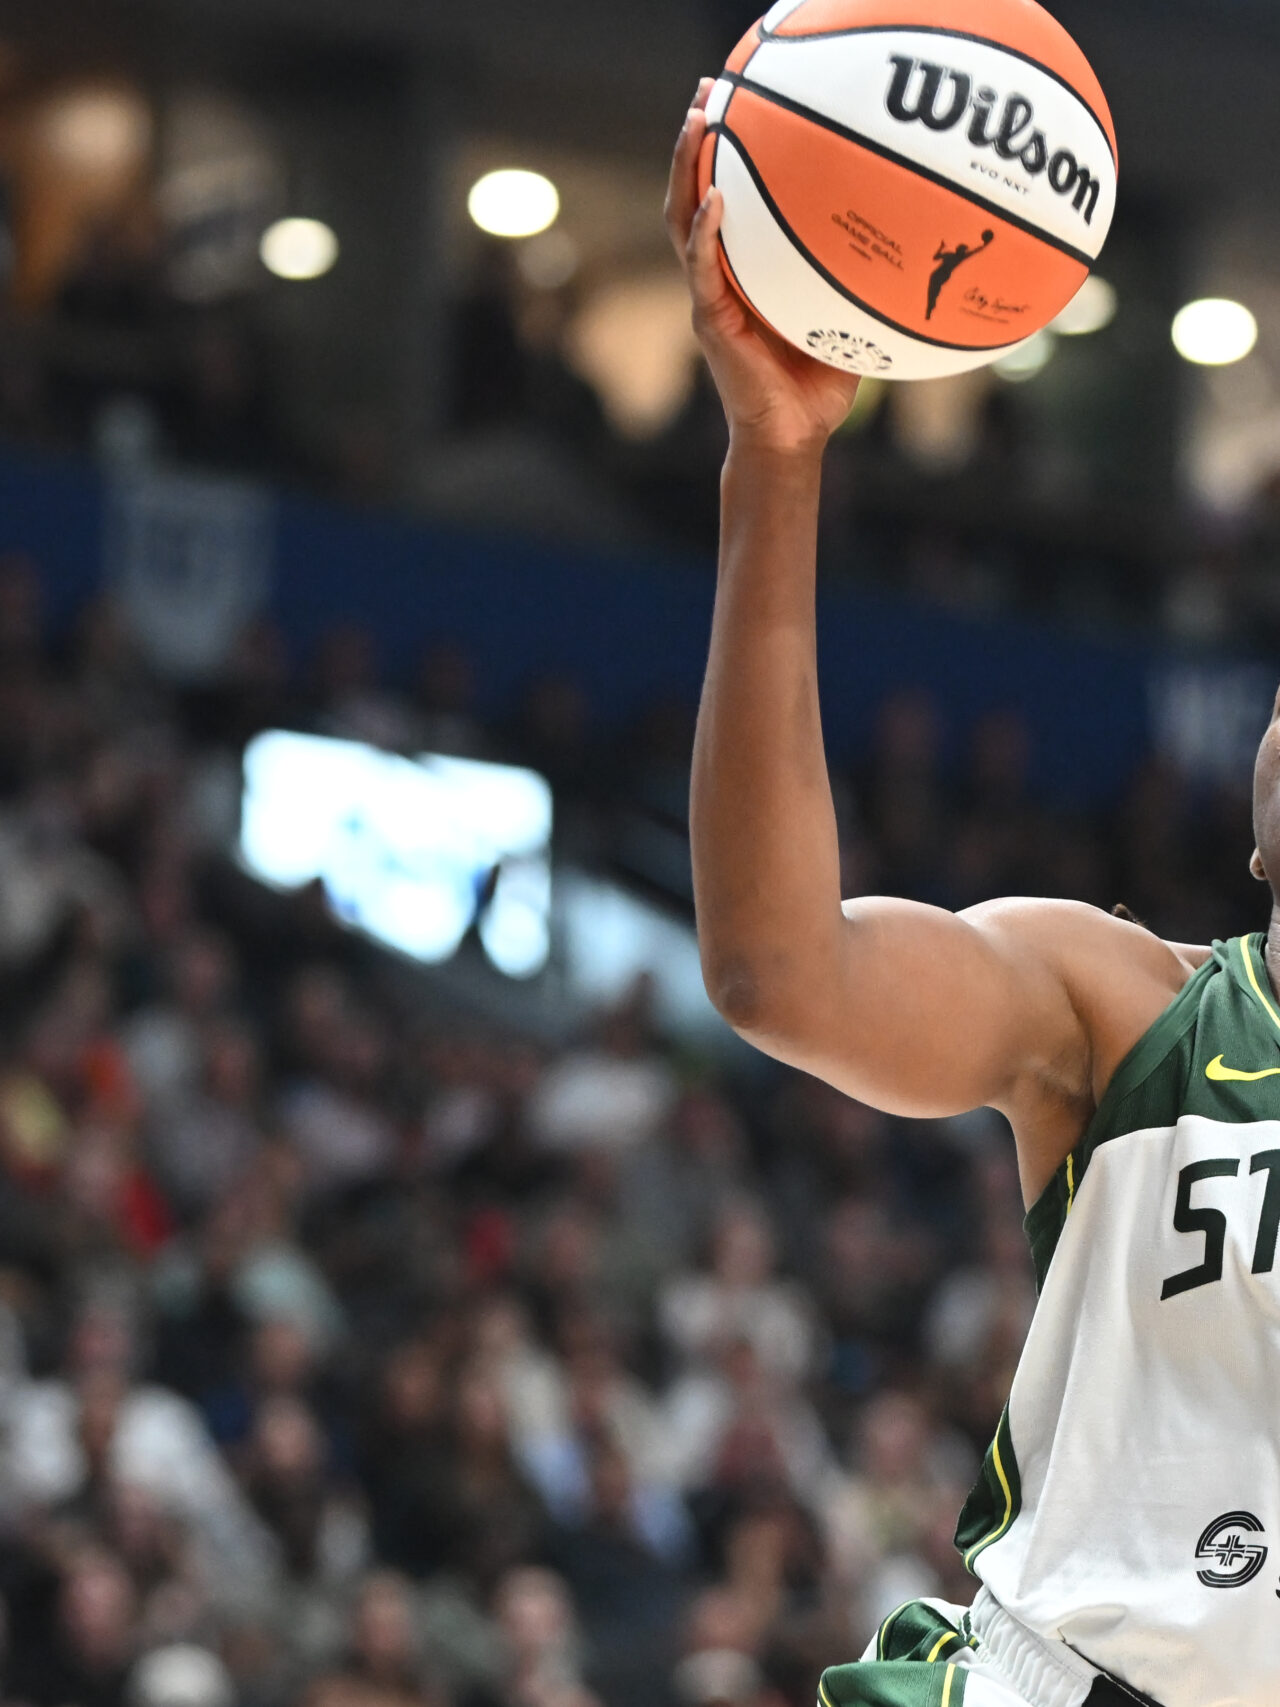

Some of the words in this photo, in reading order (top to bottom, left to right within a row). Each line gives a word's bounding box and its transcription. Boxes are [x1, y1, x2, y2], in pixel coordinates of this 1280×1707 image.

[885, 52, 1100, 226] Wilson
[970, 161, 998, 179] EVO
[1003, 177, 1029, 194] NXT
[831, 213, 870, 246] GAME
[870, 243, 905, 272] BALL
[846, 209, 903, 256] OFFICIAL
